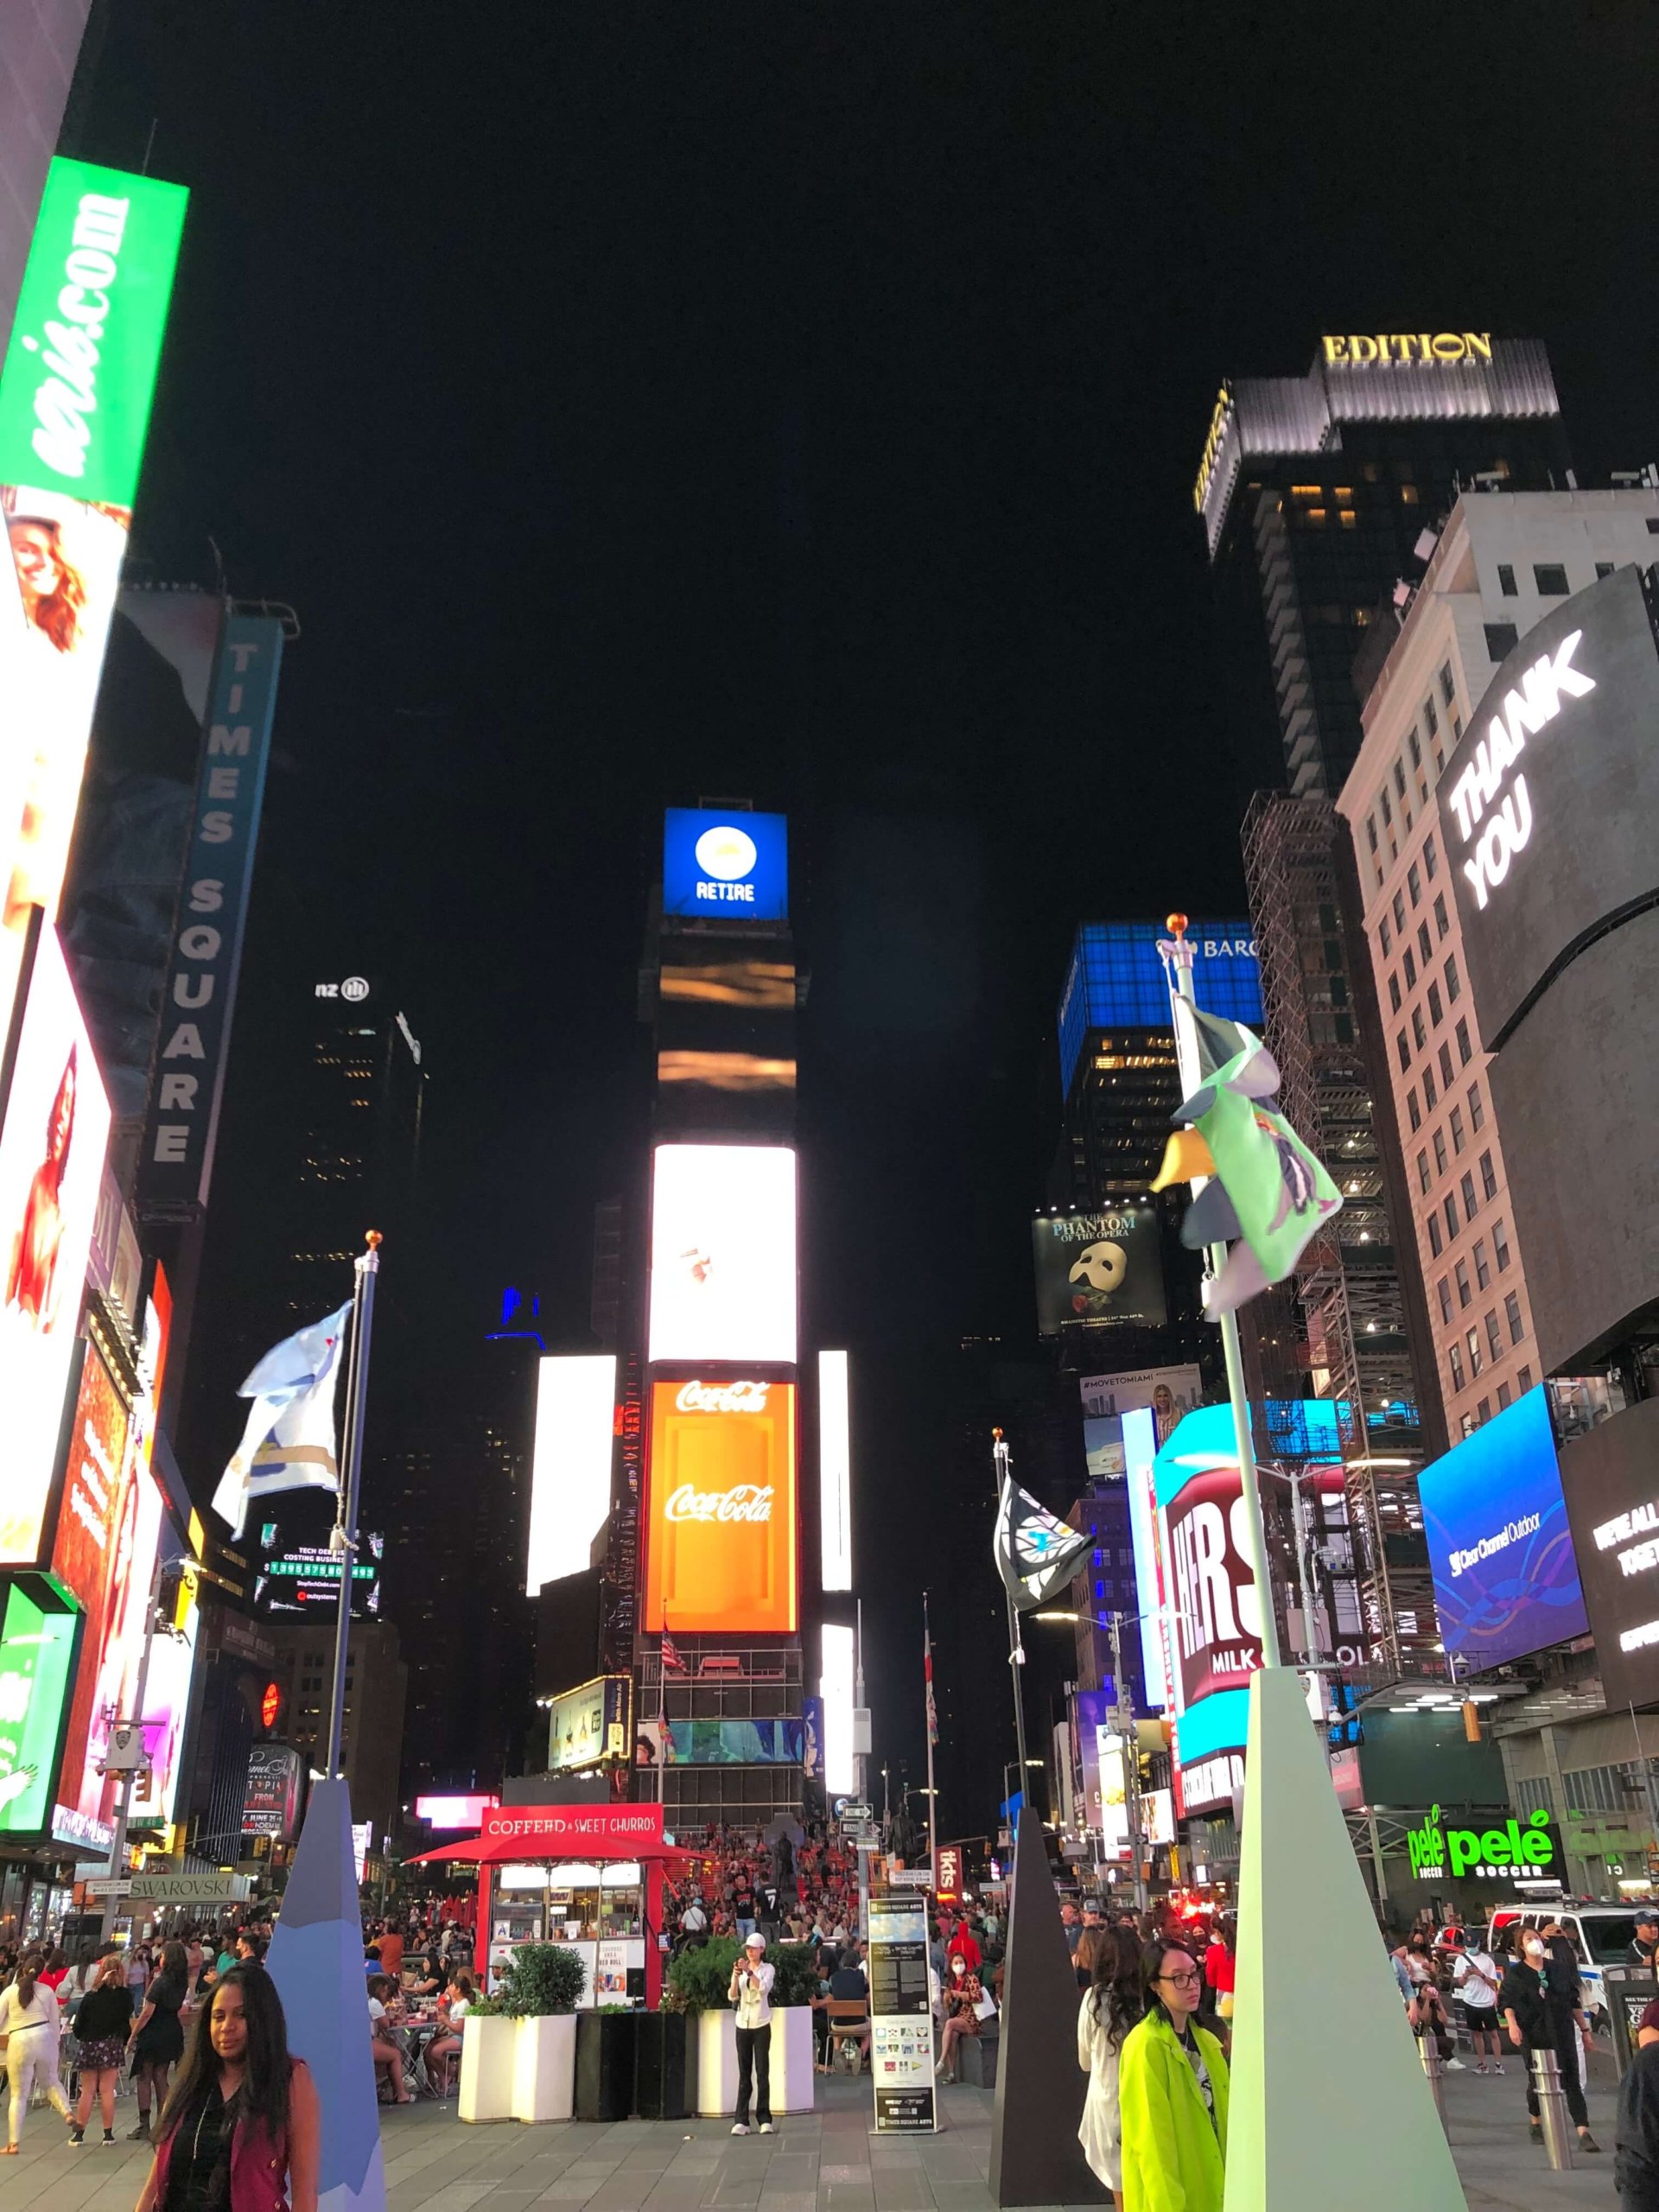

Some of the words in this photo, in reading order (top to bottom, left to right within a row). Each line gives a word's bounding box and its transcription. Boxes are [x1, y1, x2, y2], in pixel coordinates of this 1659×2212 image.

[1322, 333, 1492, 361] EDITION
[200, 642, 257, 845] TIMES
[1449, 628, 1597, 842] THANK
[1463, 772, 1533, 911] YOU
[696, 881, 755, 902] RETIRE
[154, 878, 224, 1163] SQUARE
[1052, 1216, 1137, 1236] PHANTOM
[1084, 1212, 1103, 1222] THE
[1060, 1234, 1076, 1243] OF
[1076, 1232, 1096, 1242] THE
[1096, 1229, 1130, 1239] OPERA
[1084, 1373, 1154, 1389] #MOVETOMIAMI
[676, 1380, 772, 1413] Coca-Cola
[664, 1483, 775, 1522] Coca-Cola
[1478, 1526, 1510, 1559] Channel
[1509, 1512, 1540, 1541] Outdoor
[283, 1554, 315, 1562] COSTING
[315, 1554, 359, 1564] BUSINESS
[1212, 1648, 1257, 1675] MILK
[254, 1792, 275, 1802] FROM
[137, 1818, 144, 1827] W
[575, 1818, 607, 1834] SWEET
[610, 1817, 656, 1833] CHURROS
[1408, 1803, 1444, 1879] pelé
[1446, 1808, 1553, 1876] pelé
[939, 1850, 957, 1889] tkts
[1419, 1866, 1443, 1878] SOCCER
[1475, 1865, 1543, 1877] SOCCER
[131, 1879, 231, 1897] SWAROVSKI
[766, 1890, 776, 1910] 7
[498, 1923, 506, 1936] A
